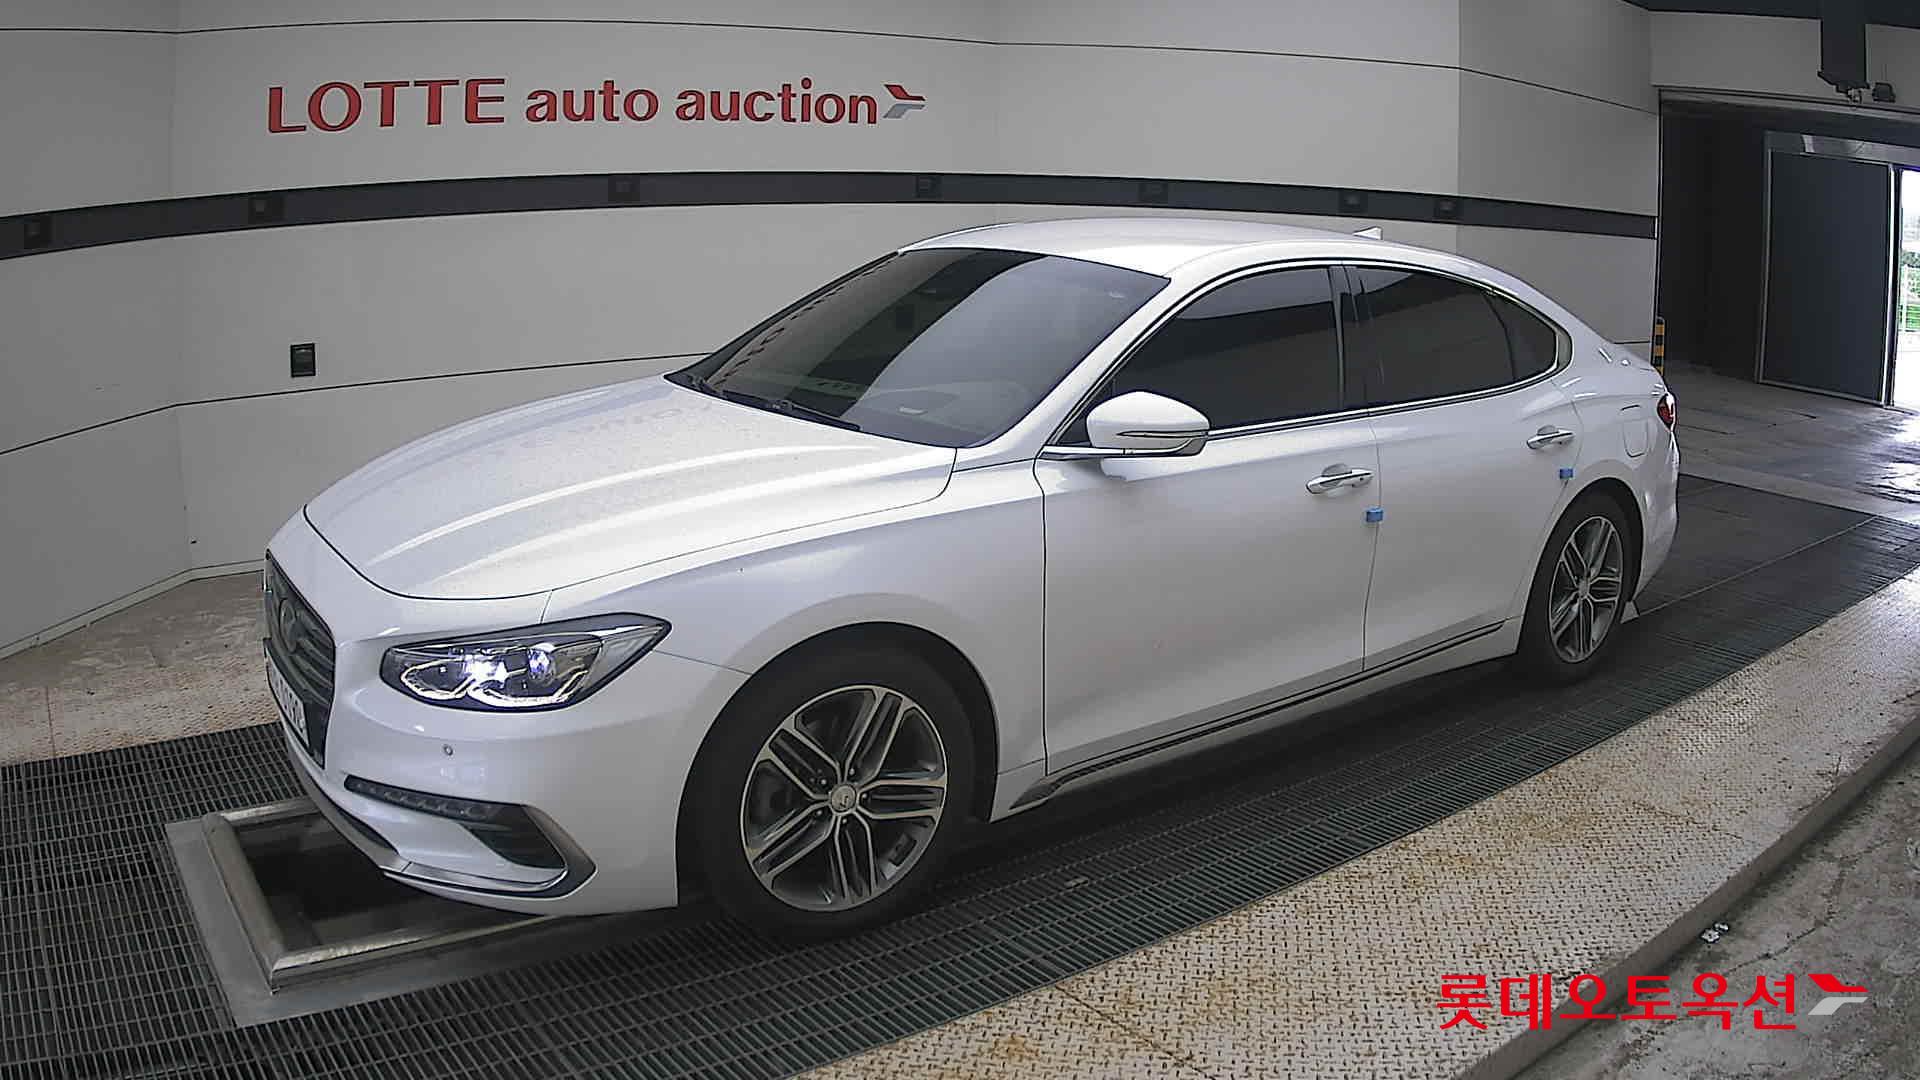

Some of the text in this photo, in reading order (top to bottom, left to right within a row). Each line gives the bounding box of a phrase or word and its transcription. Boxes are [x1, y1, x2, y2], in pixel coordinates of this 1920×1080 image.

[268, 77, 877, 133] LOTTE auto auction
